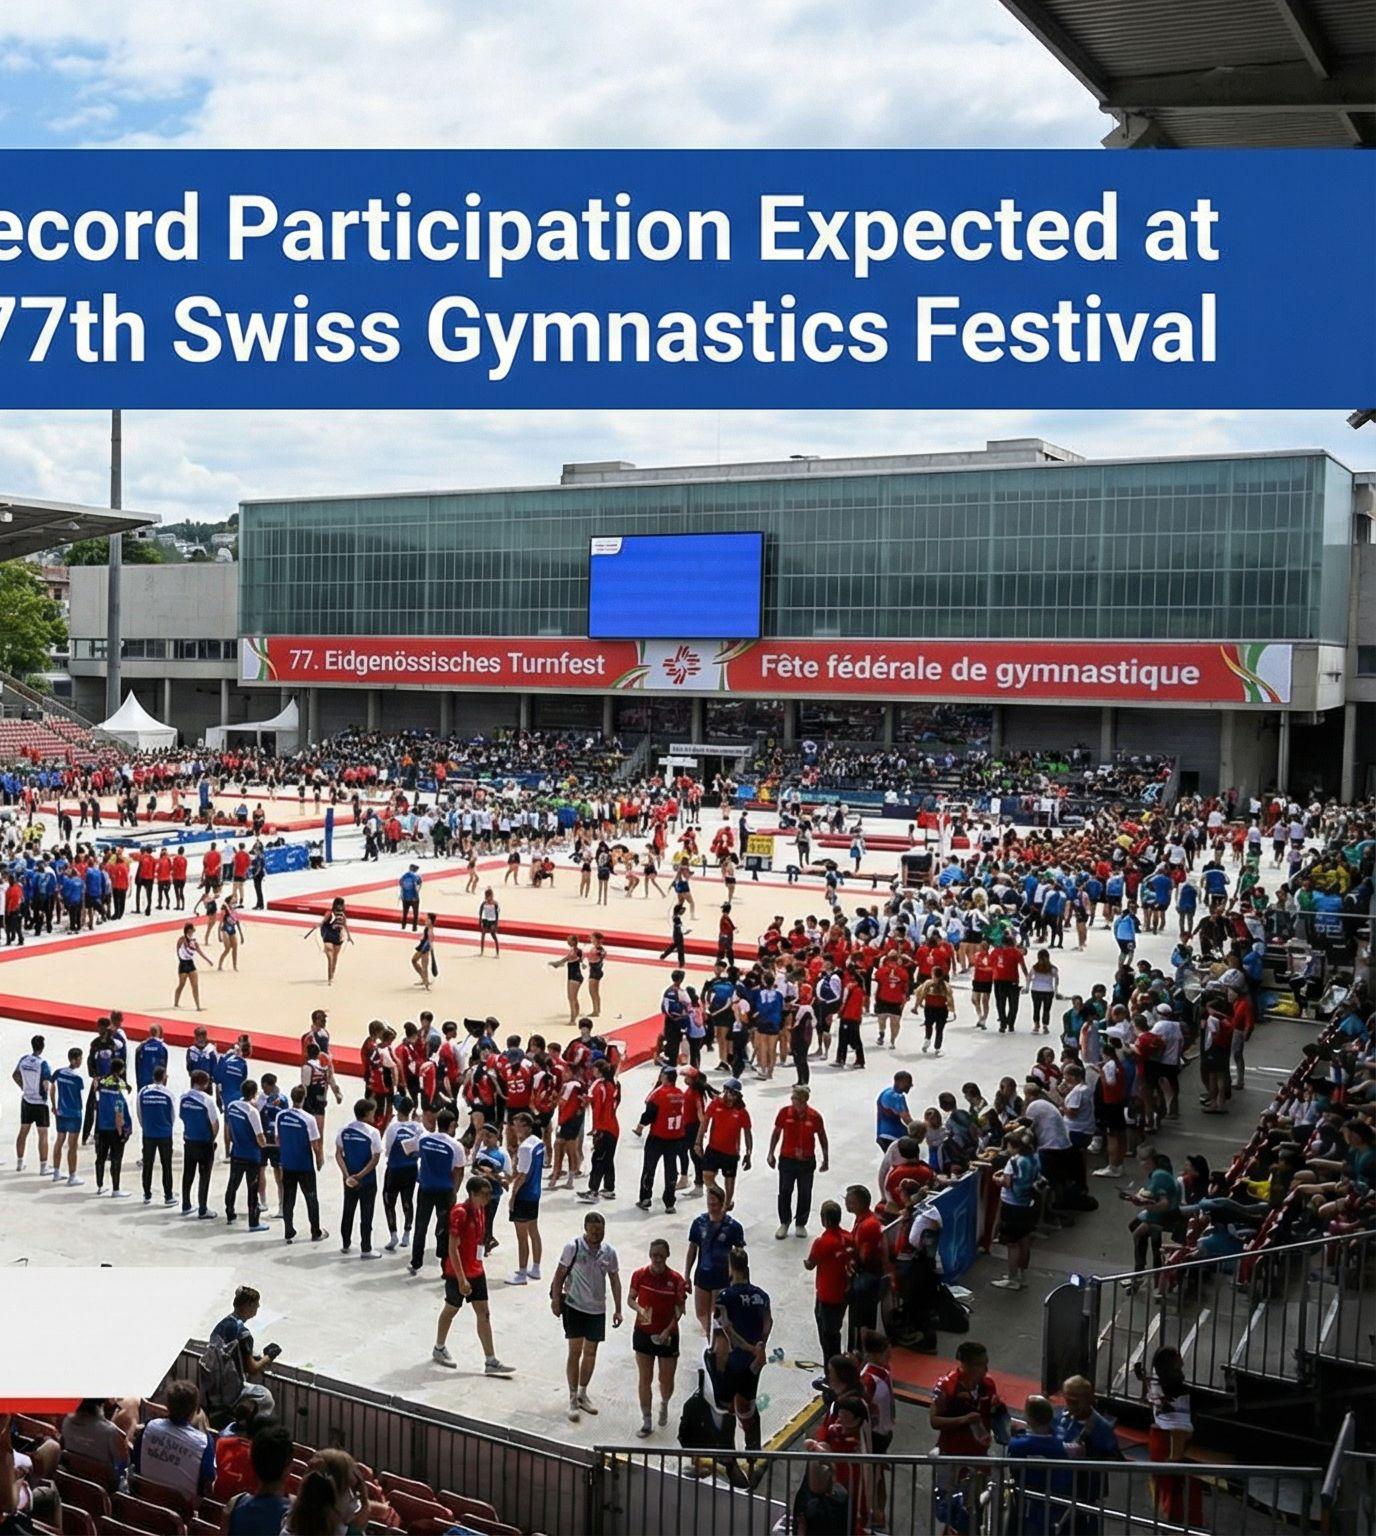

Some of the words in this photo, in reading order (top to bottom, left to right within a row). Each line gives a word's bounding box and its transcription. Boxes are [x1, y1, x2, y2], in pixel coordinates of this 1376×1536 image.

[288, 649, 320, 671] 77.
[325, 649, 502, 677] Eidgenössisches
[506, 651, 606, 676] Turnfest
[760, 653, 820, 680] Fête
[826, 654, 943, 682] fédérale
[950, 656, 988, 682] de
[995, 657, 1201, 691] gymnastique
